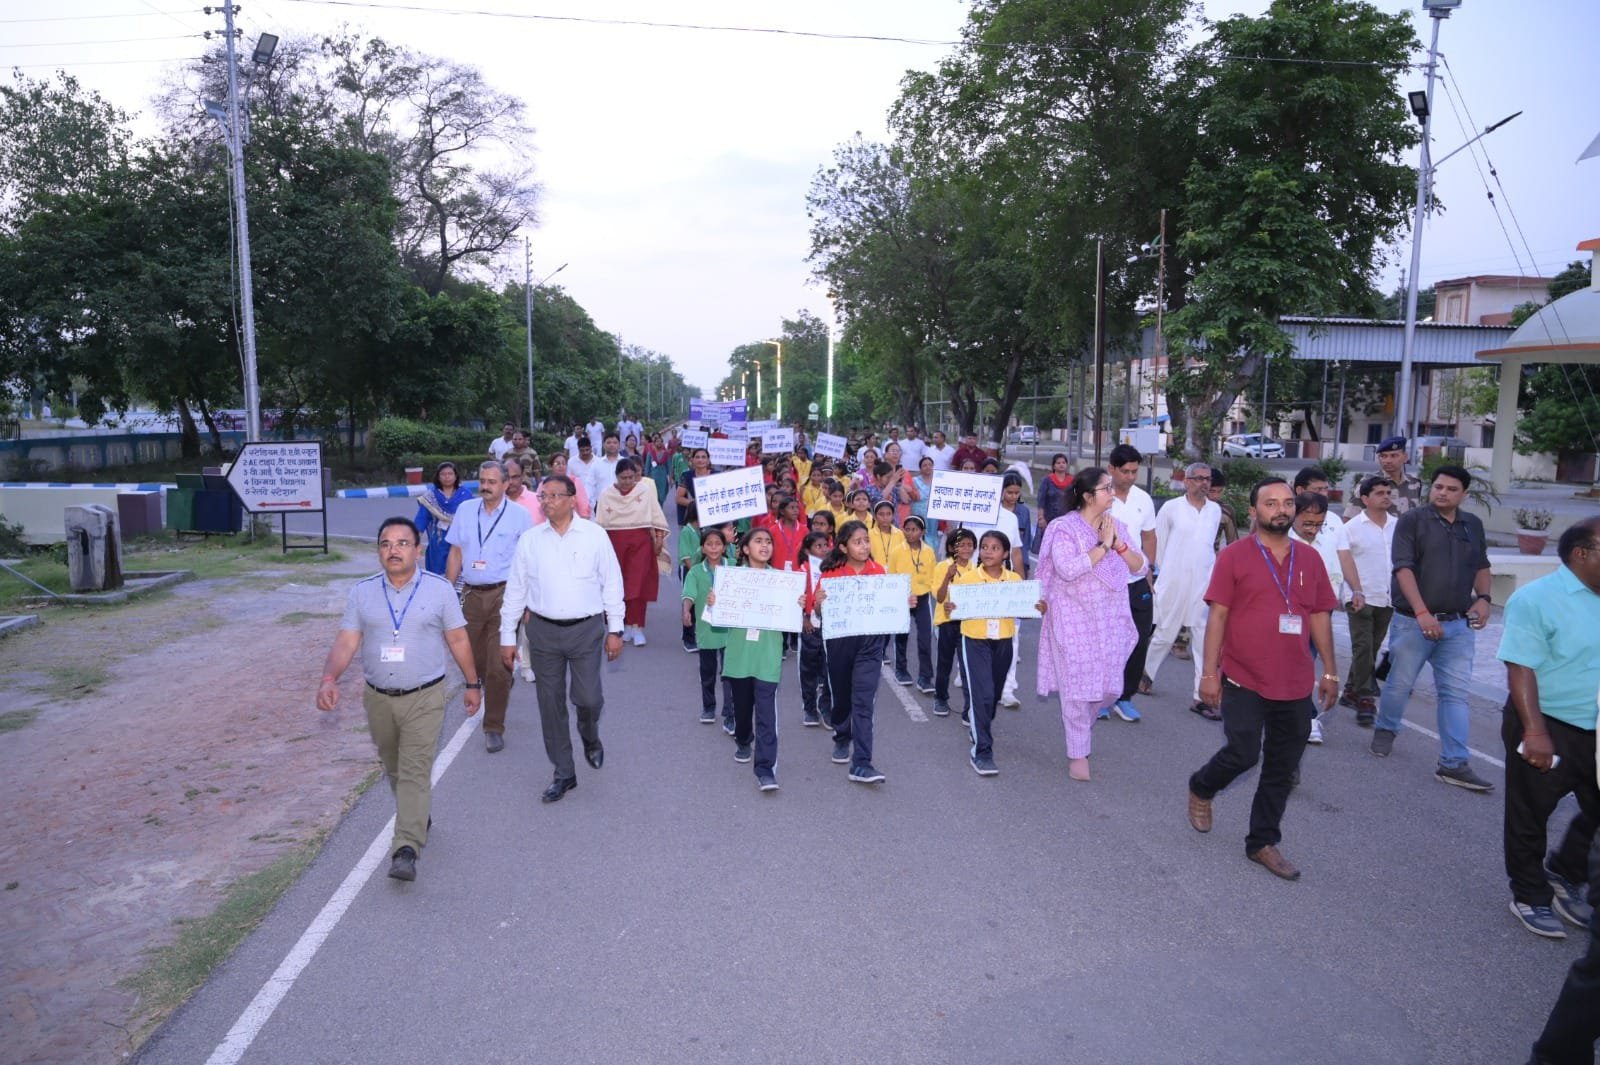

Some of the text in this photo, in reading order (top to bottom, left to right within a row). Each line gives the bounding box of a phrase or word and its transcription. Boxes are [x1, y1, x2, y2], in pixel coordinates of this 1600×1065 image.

[270, 486, 298, 496] स्टेशन
[955, 488, 962, 496] का
[932, 497, 992, 512] इसे अपना धर्म बनाओ
